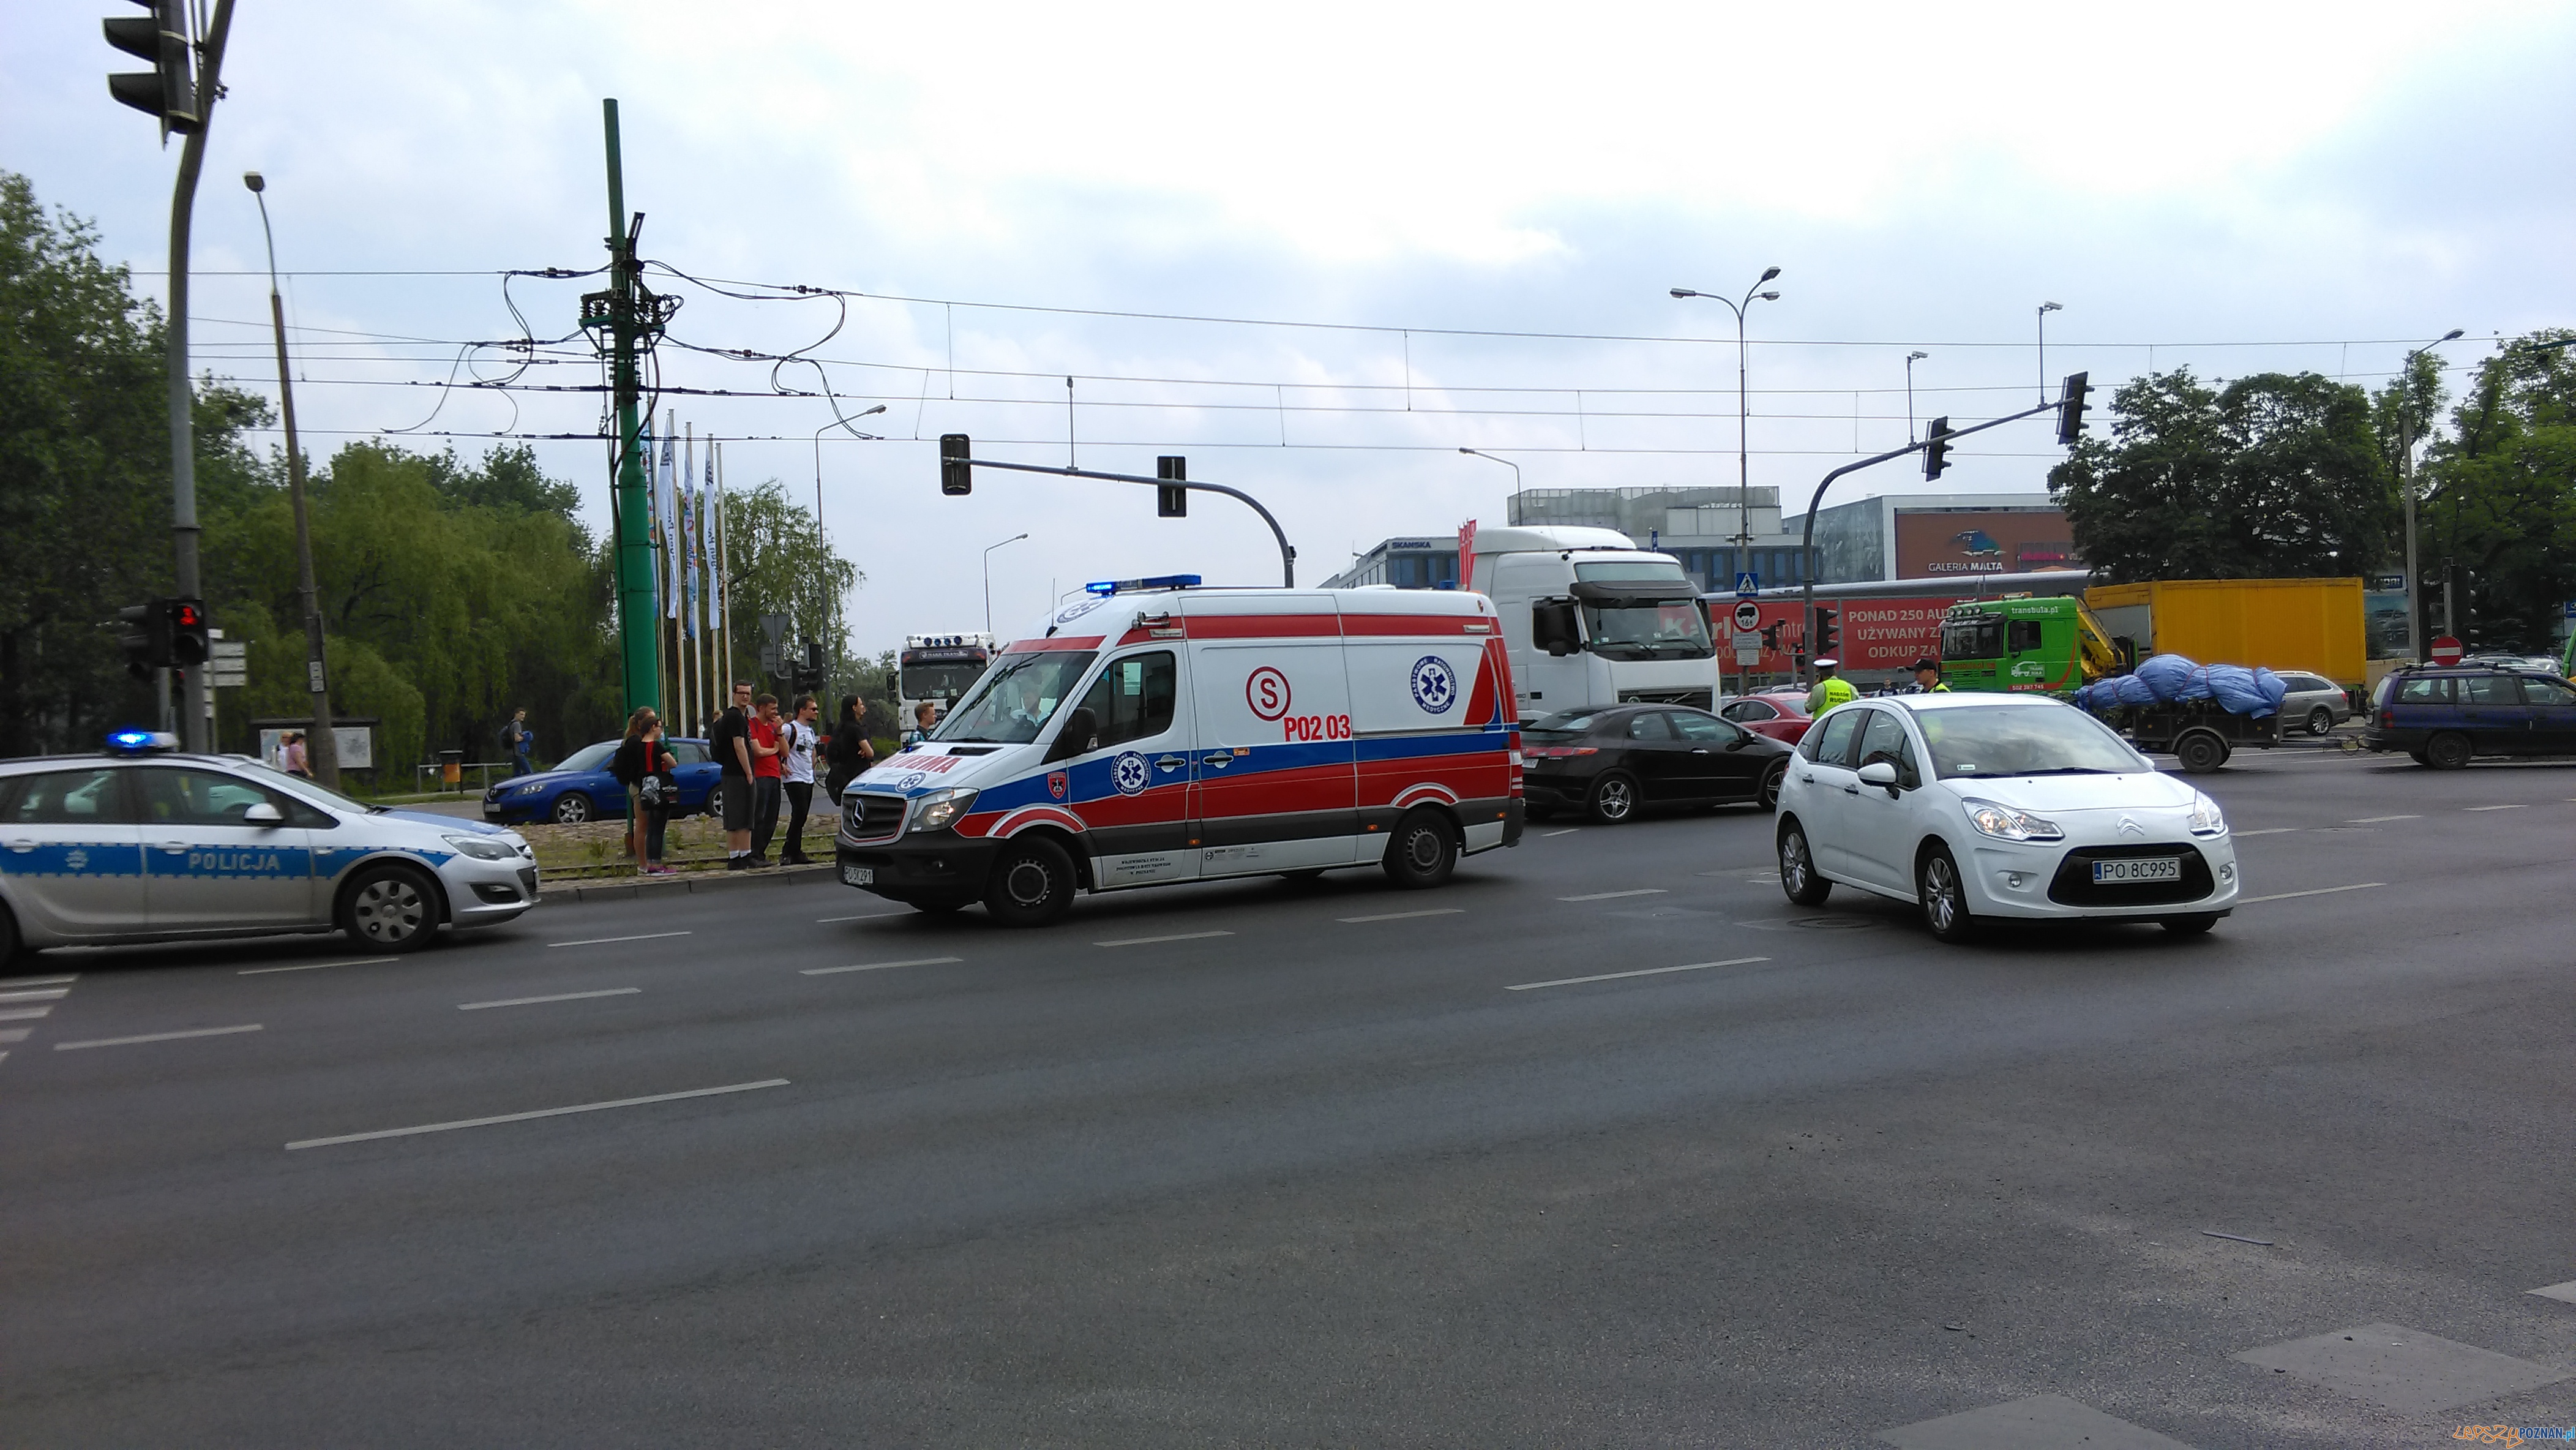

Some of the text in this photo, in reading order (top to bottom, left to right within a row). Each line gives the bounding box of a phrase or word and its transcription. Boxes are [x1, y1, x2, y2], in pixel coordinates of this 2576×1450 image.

[1928, 562, 2003, 571] GALERIA MALTA
[1849, 610, 1896, 622] PONAD
[1900, 609, 1924, 620] 250
[2011, 606, 2058, 615] transbula.pl
[1857, 626, 1926, 640] UŻYWANY
[1868, 645, 1938, 658] ODKUP ZA
[1260, 678, 1278, 709] S
[1326, 715, 1350, 740] 03
[189, 853, 280, 871] POLICJA
[2103, 862, 2176, 879] PO 8C995
